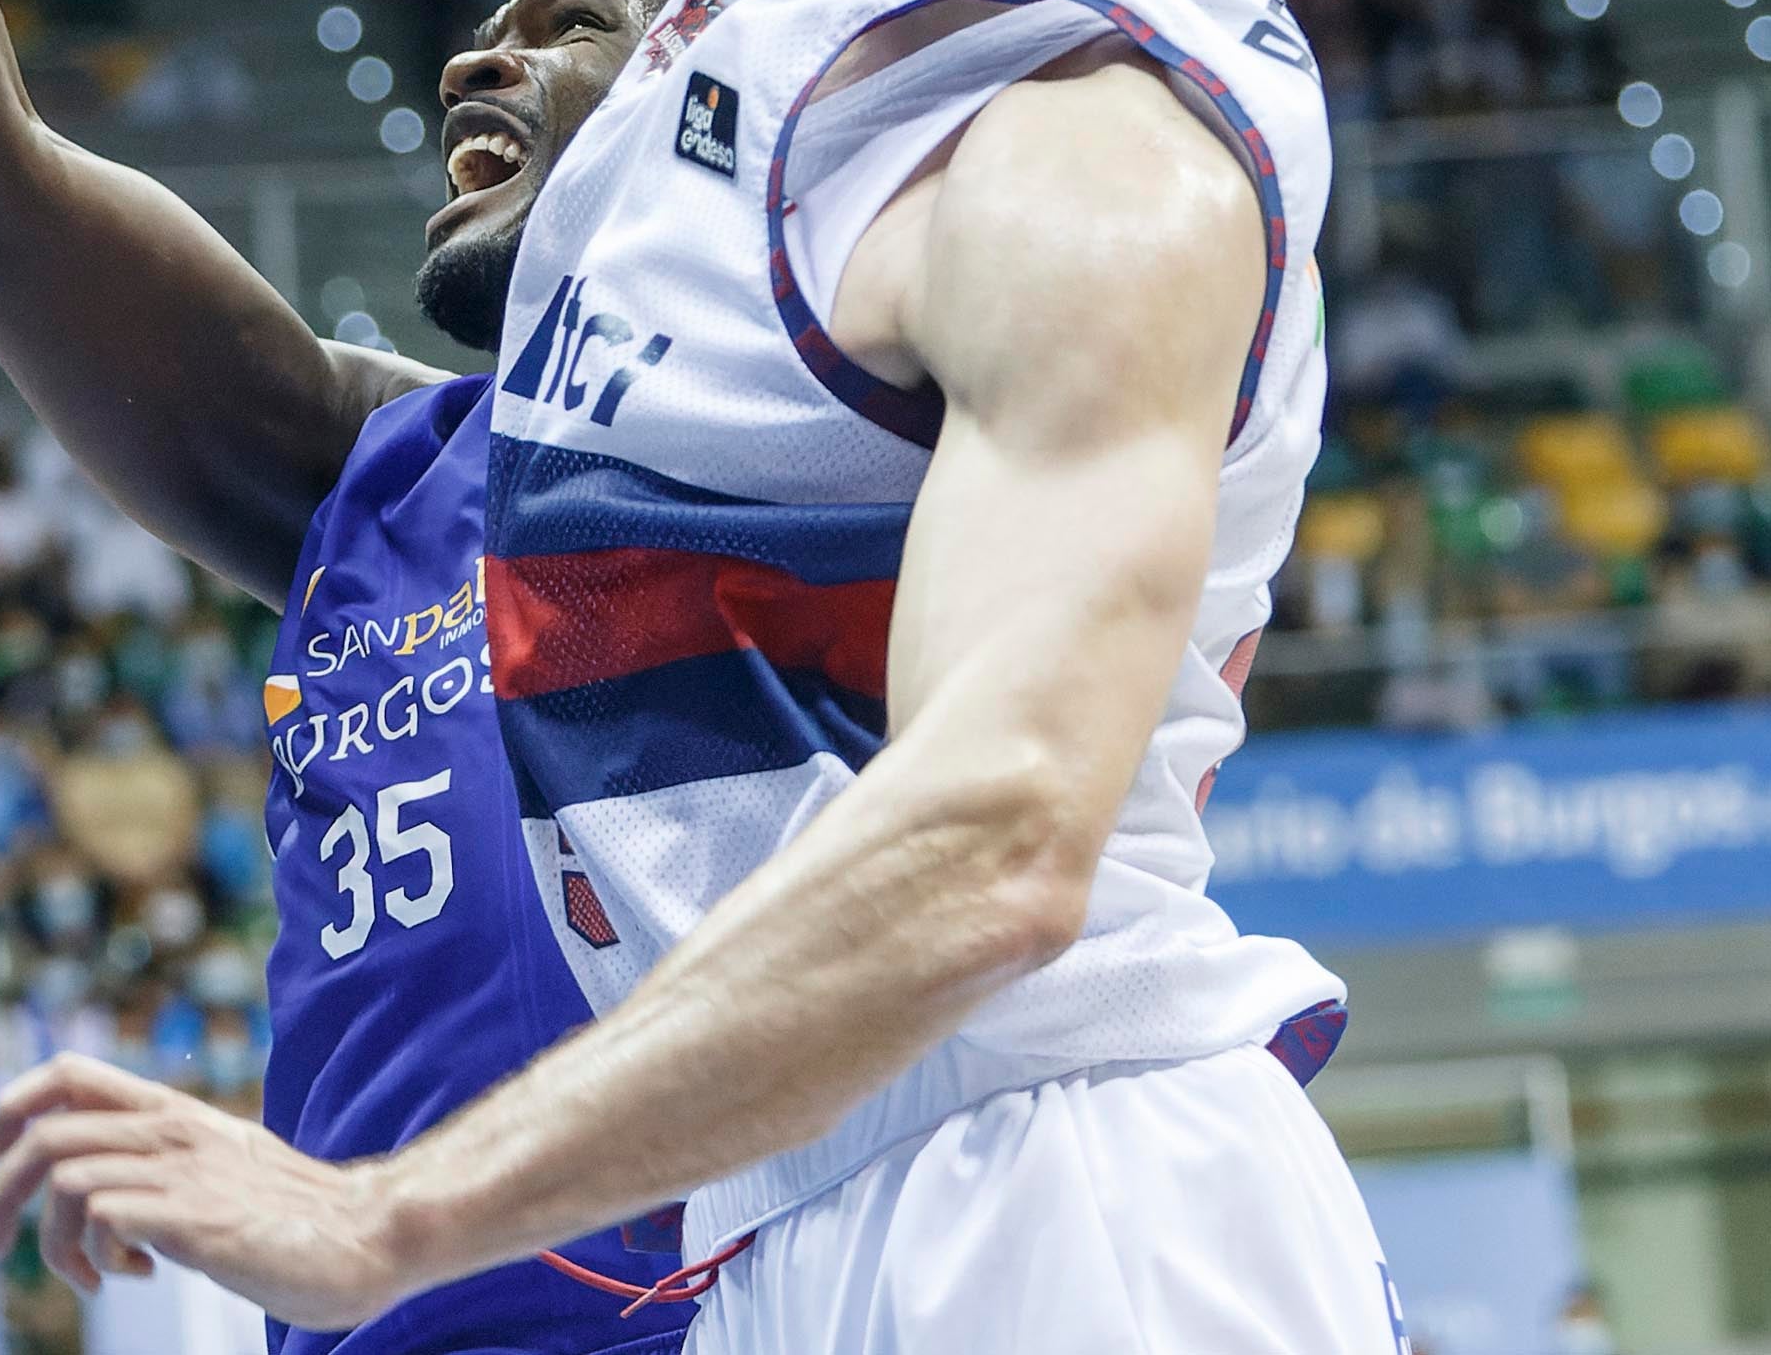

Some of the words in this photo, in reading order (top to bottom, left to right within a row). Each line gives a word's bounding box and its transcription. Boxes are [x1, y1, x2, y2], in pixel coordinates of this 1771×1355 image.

[685, 94, 714, 131] liga
[680, 128, 734, 170] endesa
[439, 607, 487, 650] INMO
[320, 768, 454, 961] 35
